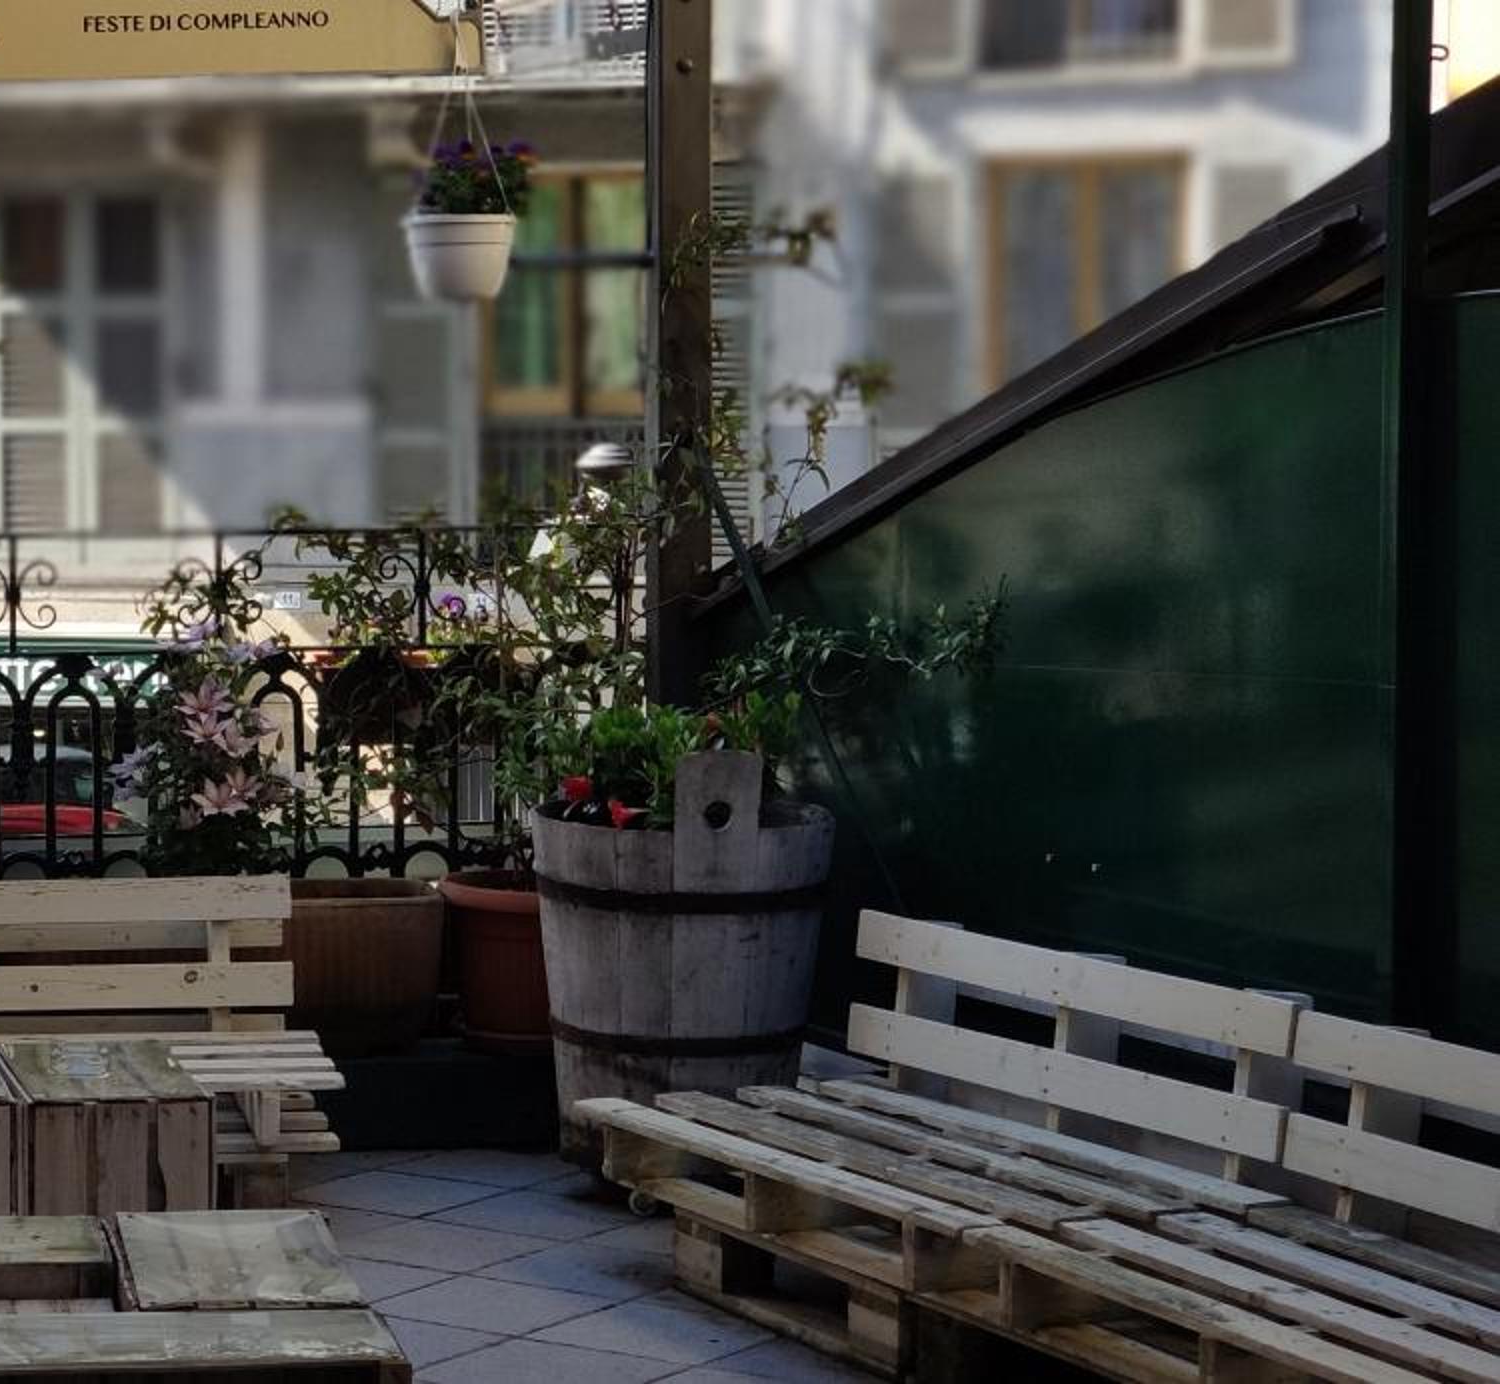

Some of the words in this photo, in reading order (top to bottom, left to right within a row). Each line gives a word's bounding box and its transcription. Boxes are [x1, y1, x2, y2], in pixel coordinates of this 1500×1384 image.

[83, 15, 145, 33] FESTE
[150, 15, 171, 31] DI
[177, 10, 329, 30] COMPLEANNO
